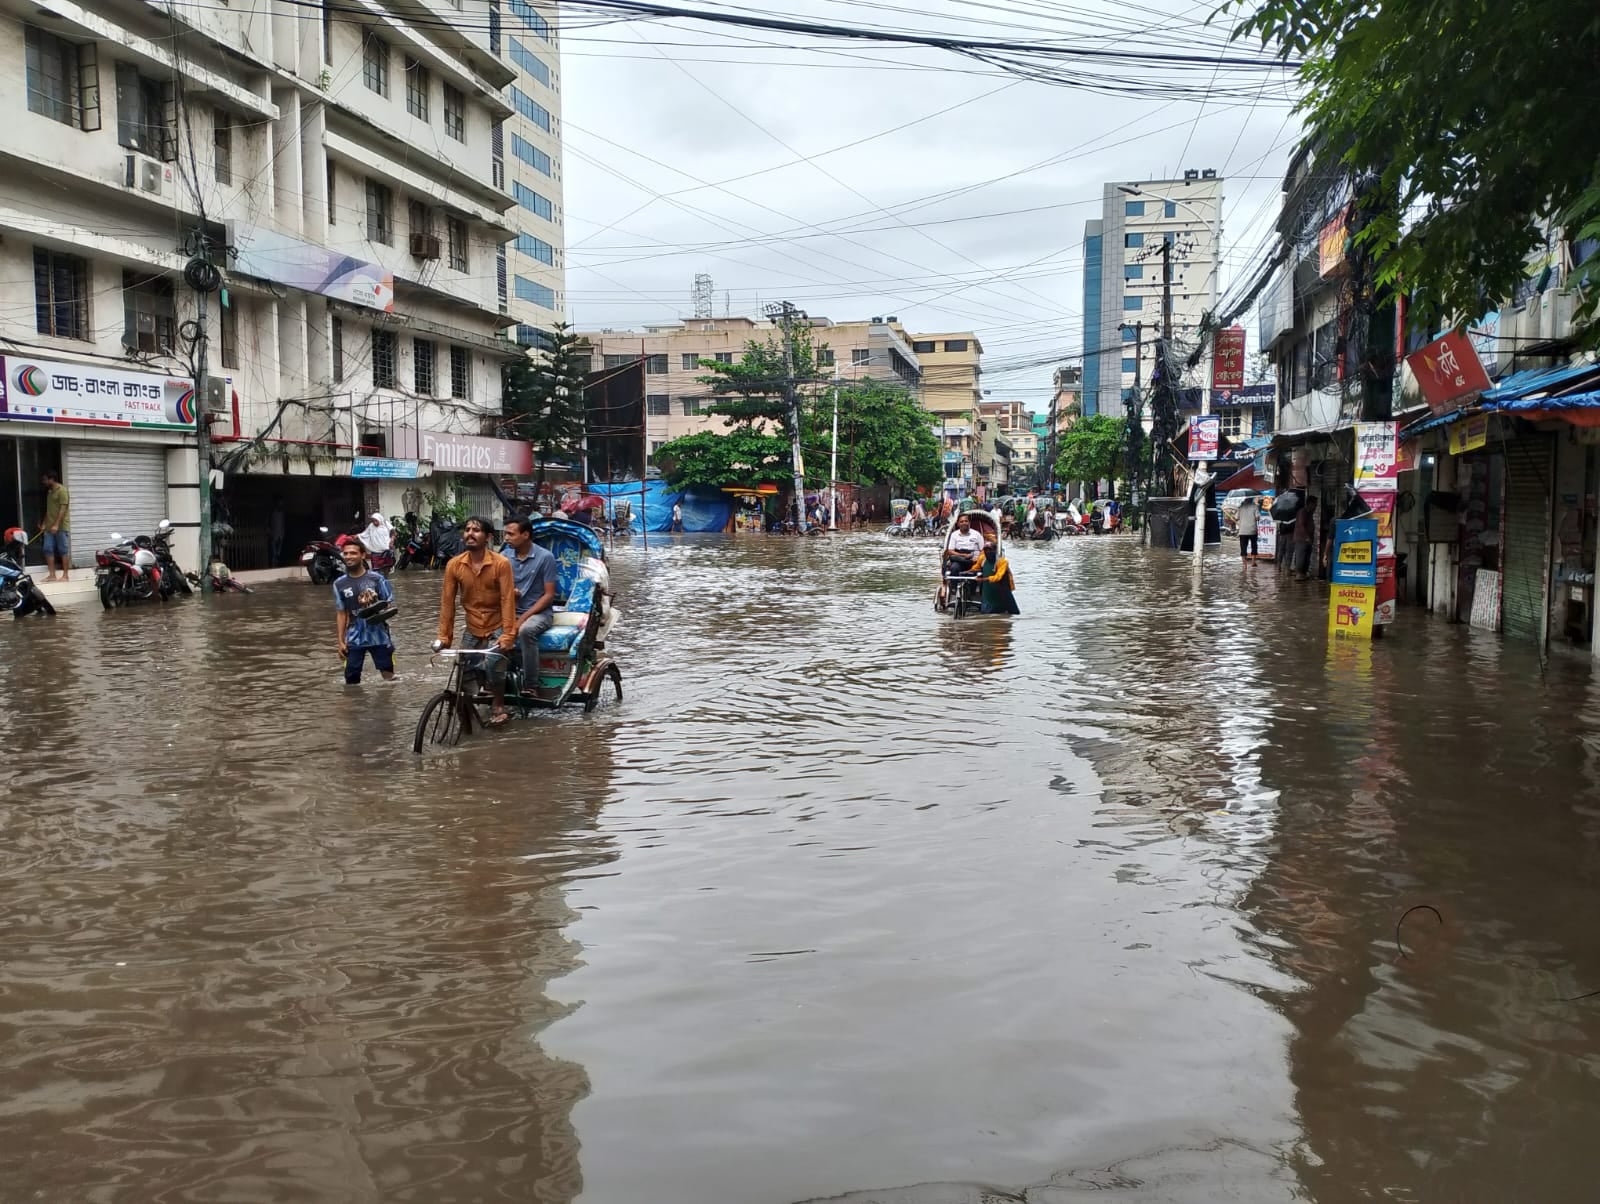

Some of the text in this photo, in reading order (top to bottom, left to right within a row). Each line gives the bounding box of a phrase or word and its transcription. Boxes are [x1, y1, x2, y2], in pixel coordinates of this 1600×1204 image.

[124, 382, 161, 399] ব্যাংক
[124, 400, 161, 412] FAST TRACK
[423, 434, 491, 469] Emirates
[1338, 590, 1365, 599] skitto
